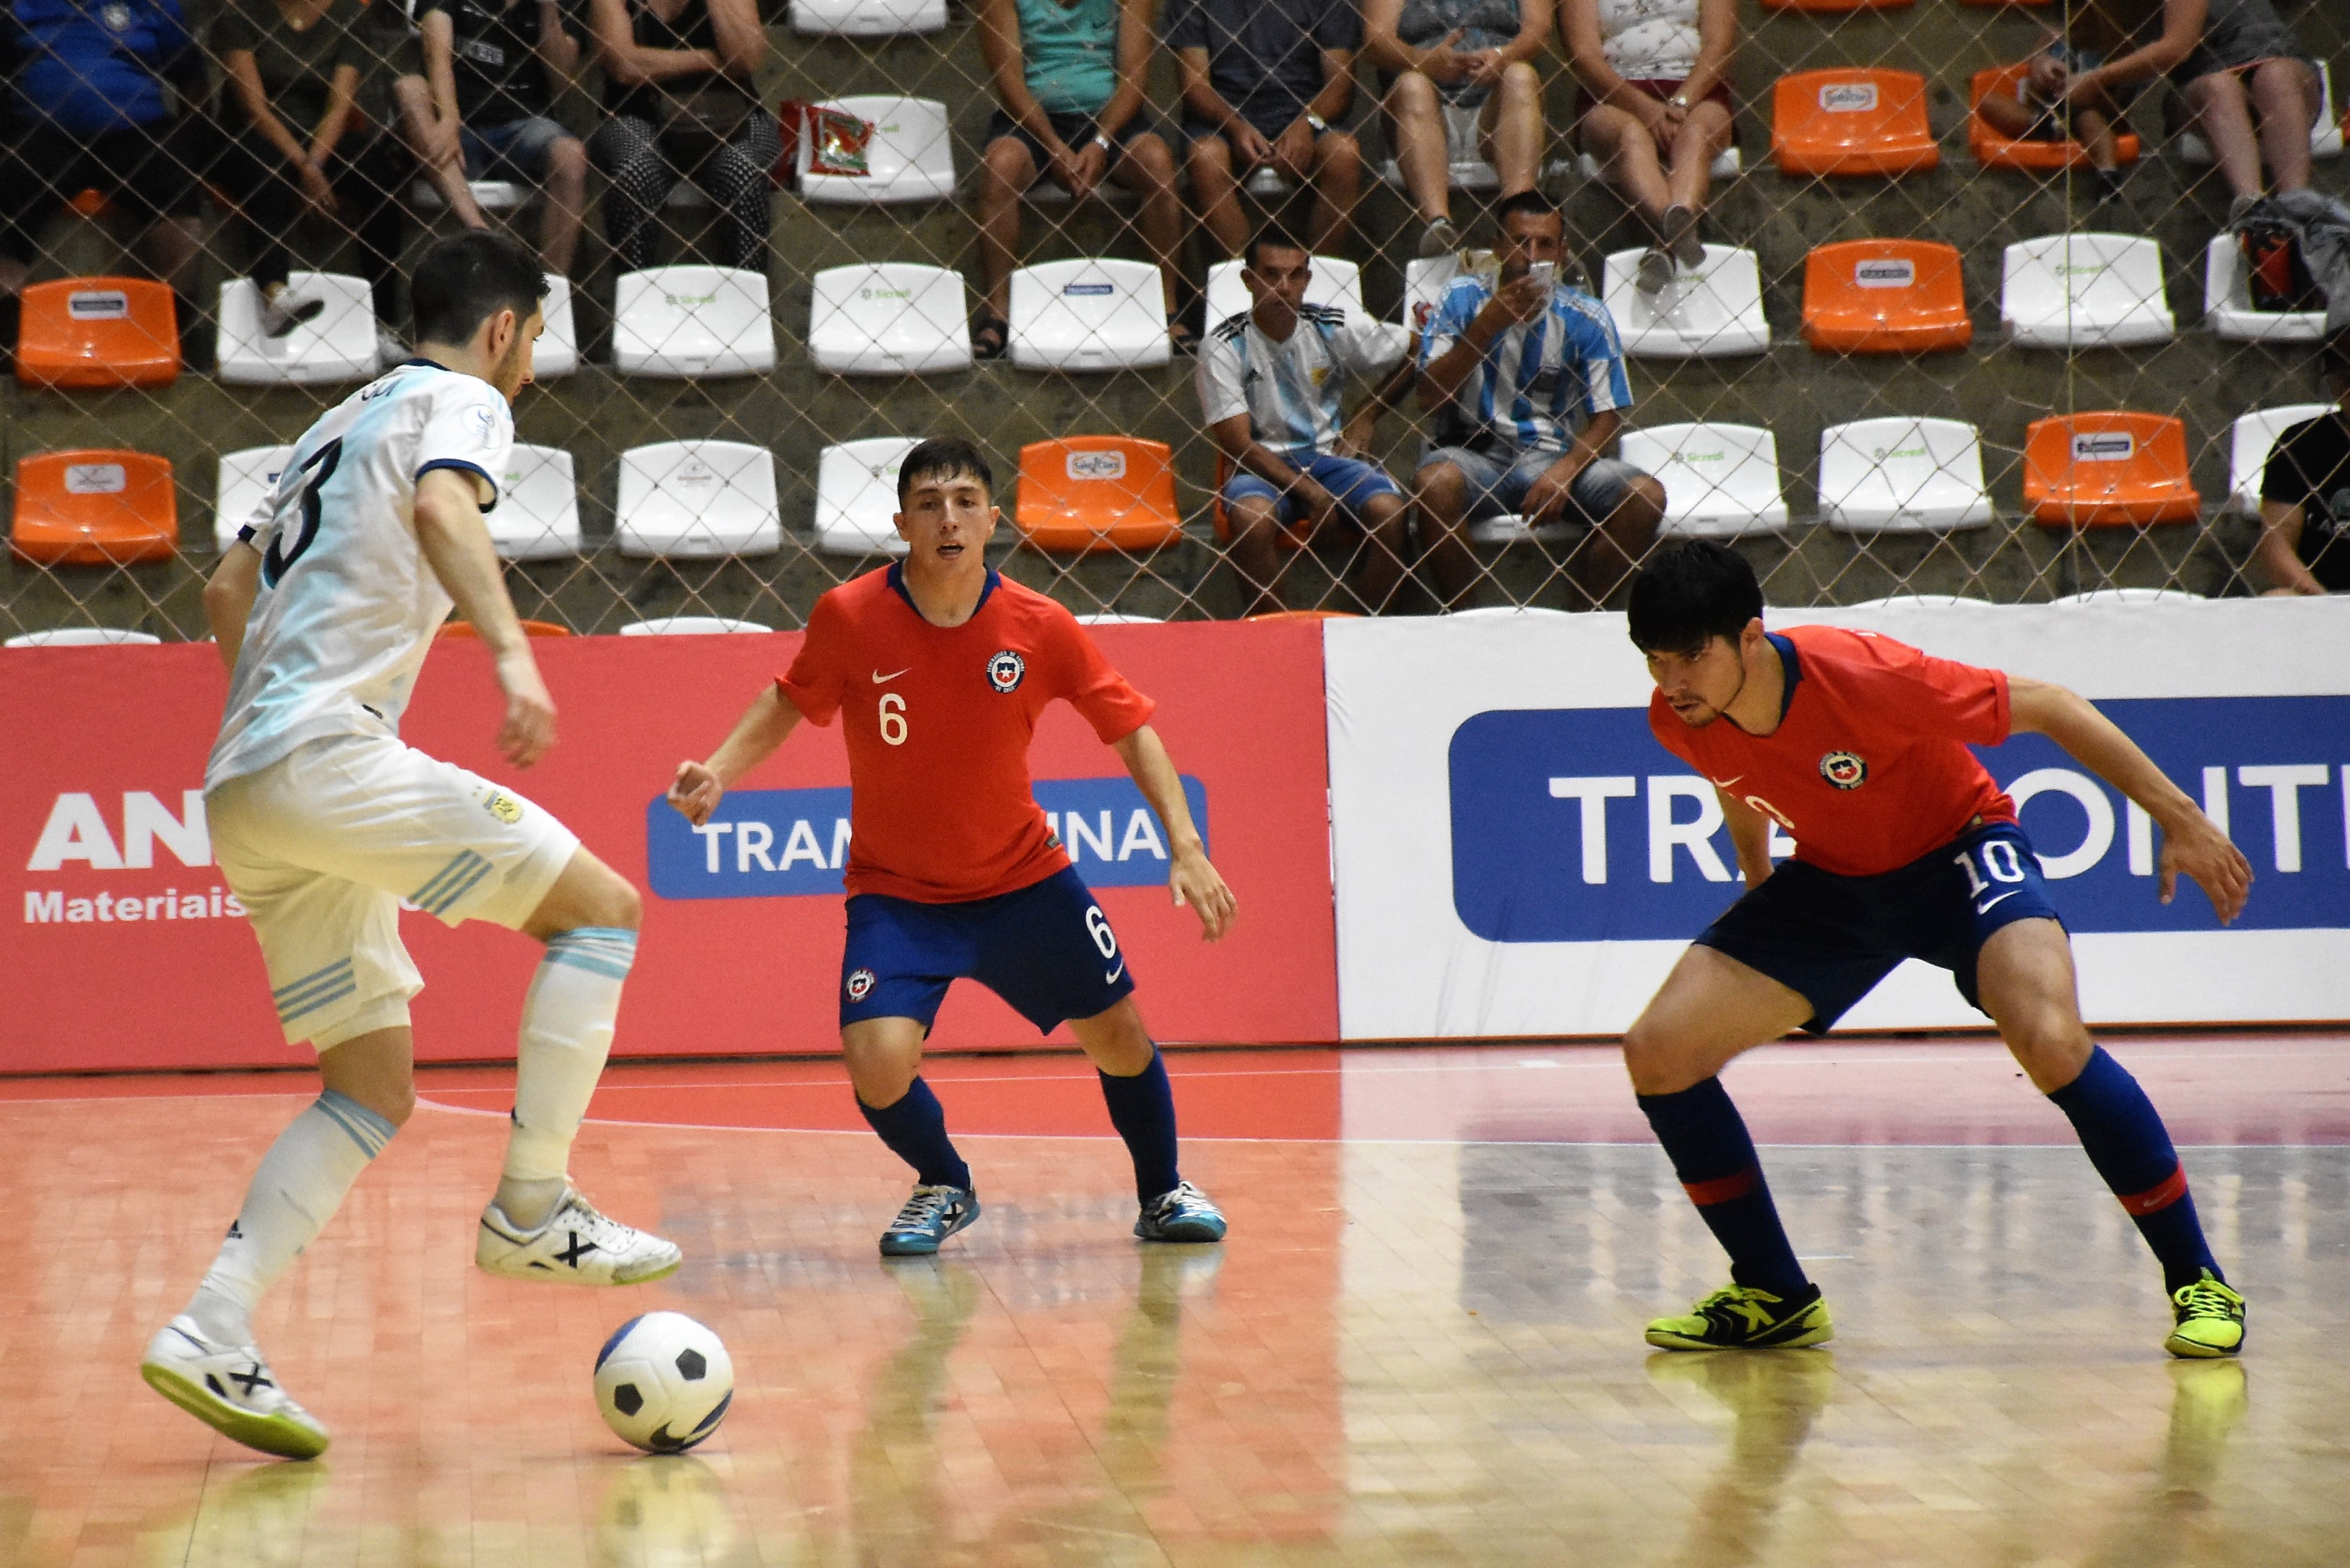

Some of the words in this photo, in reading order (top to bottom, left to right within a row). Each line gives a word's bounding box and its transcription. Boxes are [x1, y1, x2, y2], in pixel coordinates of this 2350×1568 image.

[879, 693, 907, 745] 6
[1953, 841, 2025, 899] 10
[25, 886, 248, 924] Materiais
[1085, 905, 1117, 959] 6
